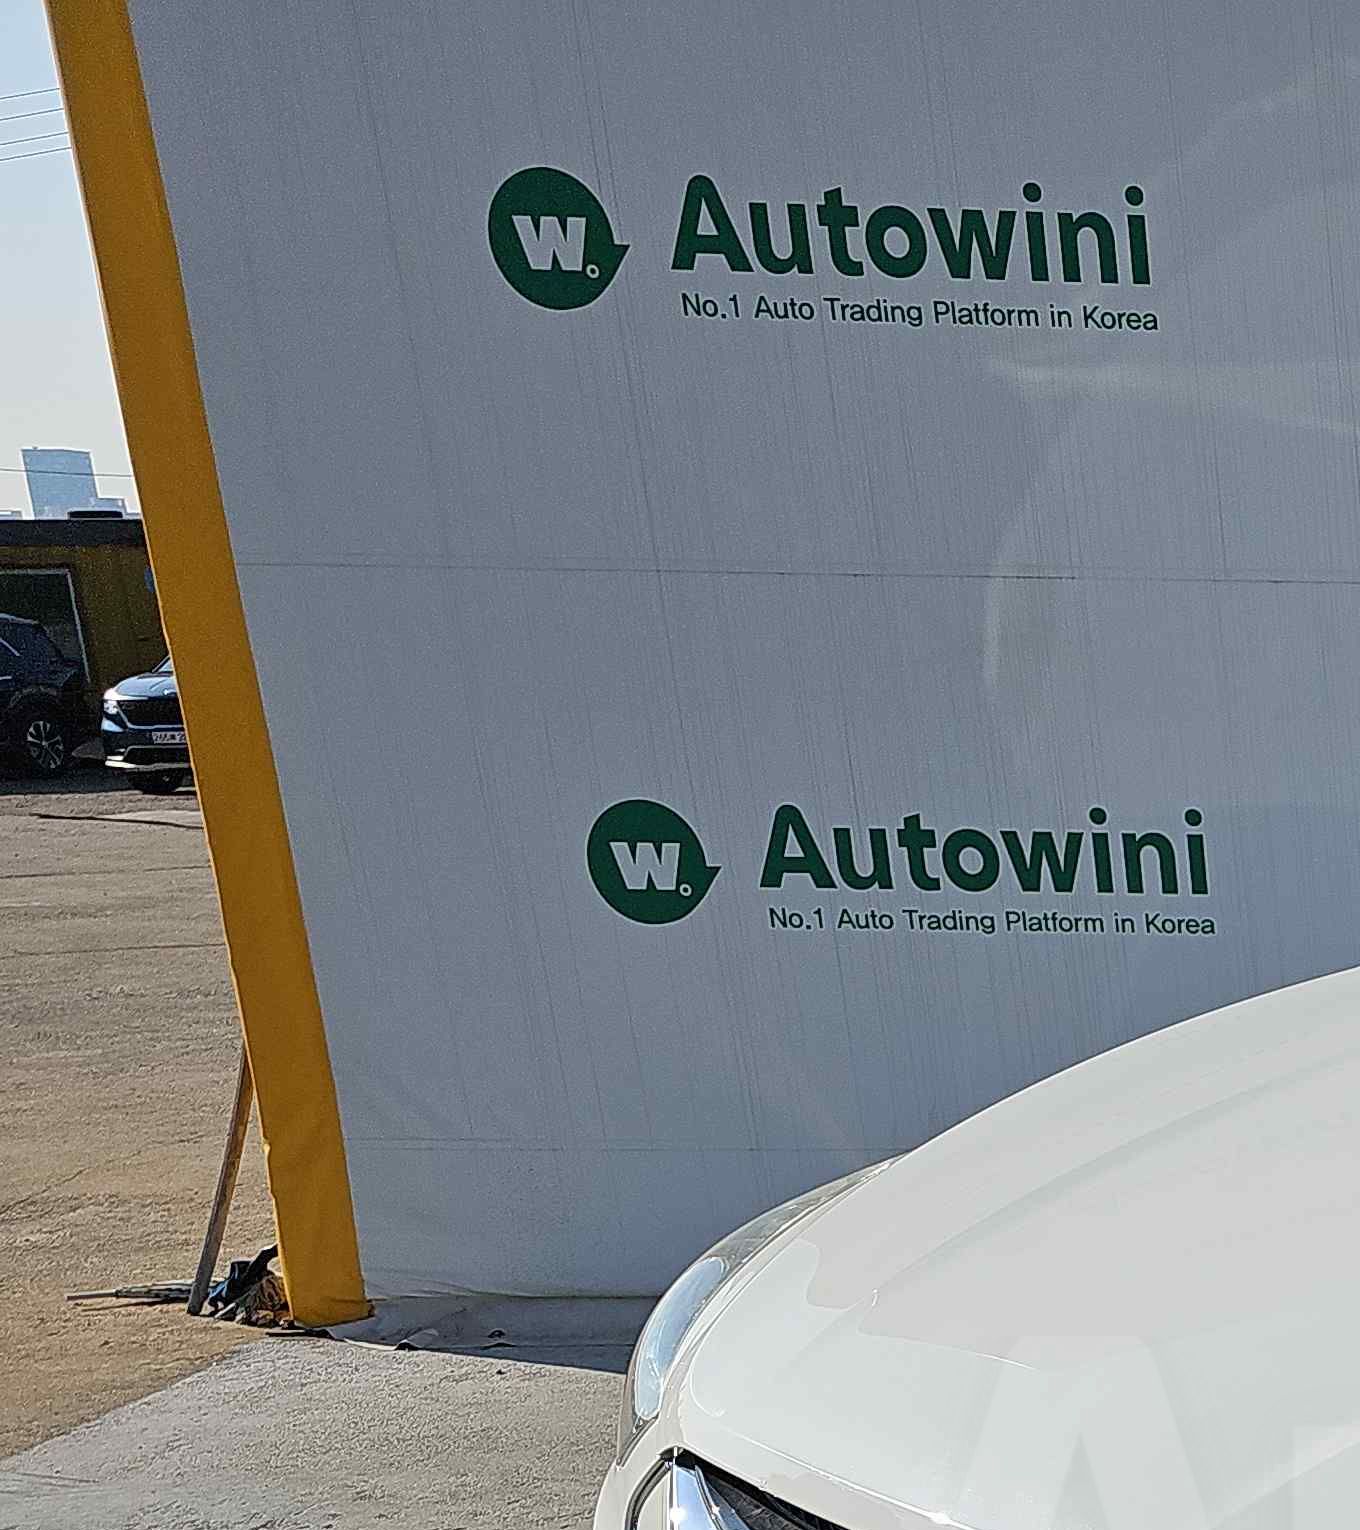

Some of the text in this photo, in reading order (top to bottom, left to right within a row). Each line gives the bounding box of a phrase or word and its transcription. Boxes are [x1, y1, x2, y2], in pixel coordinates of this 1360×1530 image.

[670, 174, 1151, 285] Autowini
[681, 292, 1158, 331] No.1 Auto Trading Platform in Korea
[759, 804, 1209, 895] Autowini
[768, 907, 1216, 935] No.1 Auto Trading Platform in Korea
